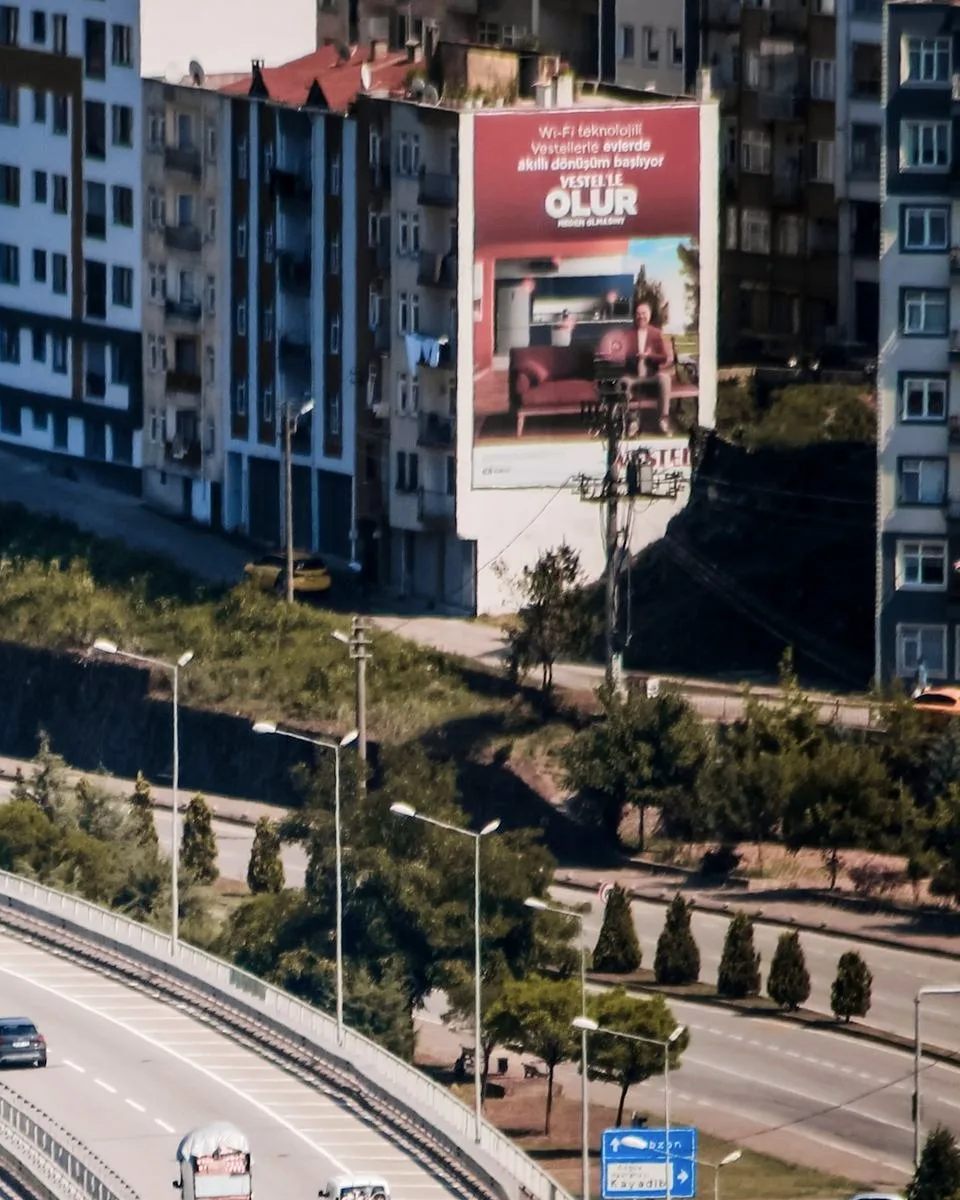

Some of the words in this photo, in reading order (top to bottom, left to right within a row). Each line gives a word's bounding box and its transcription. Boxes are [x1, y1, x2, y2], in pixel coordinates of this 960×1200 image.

[578, 123, 642, 138] teknolojili
[602, 139, 651, 153] evlerde
[550, 155, 611, 171] dönüşüm
[613, 152, 665, 169] başlıyor
[545, 187, 638, 218] OLUR
[611, 1178, 670, 1189] Kayadib
